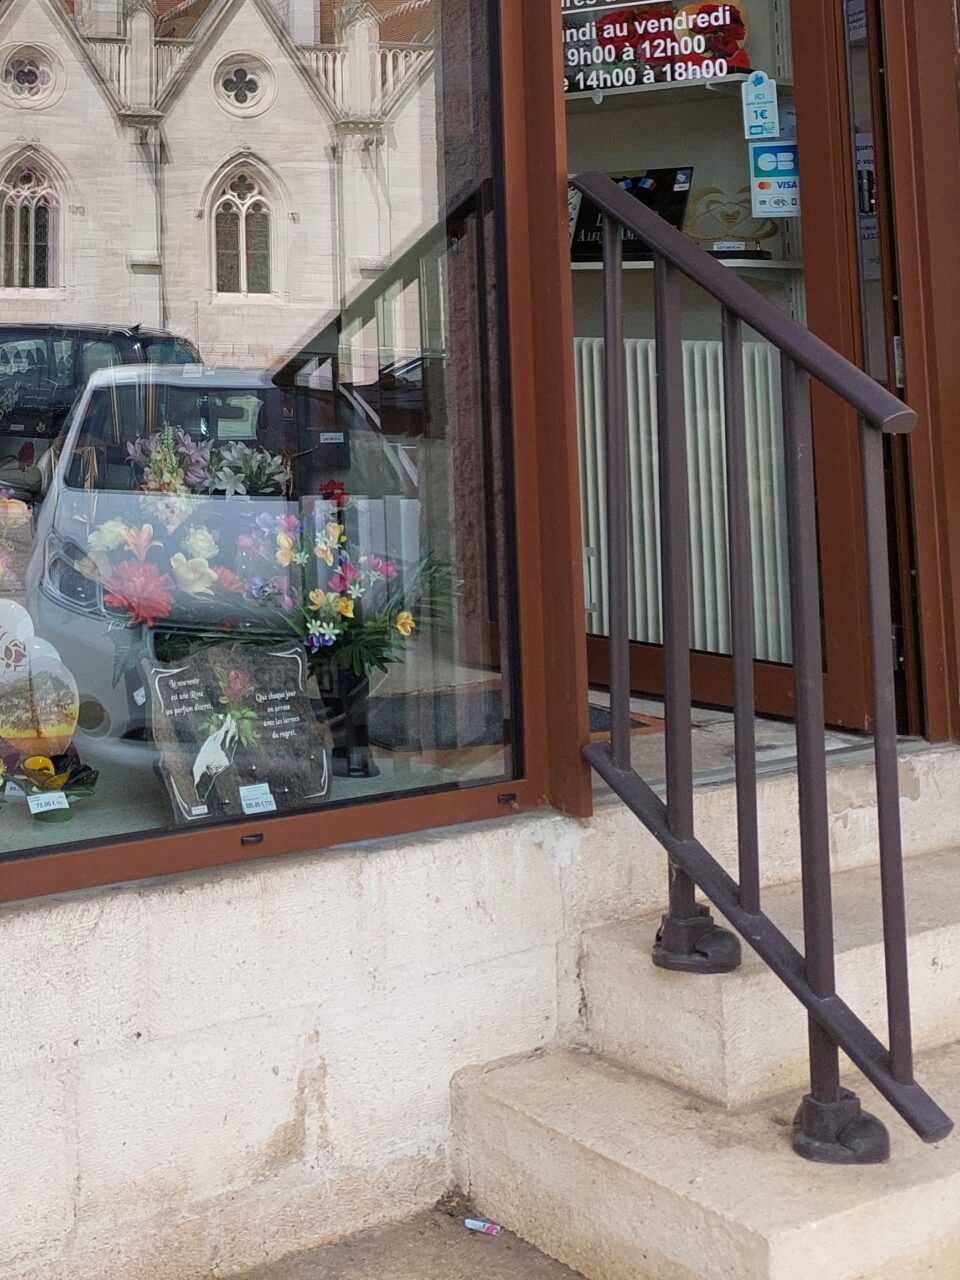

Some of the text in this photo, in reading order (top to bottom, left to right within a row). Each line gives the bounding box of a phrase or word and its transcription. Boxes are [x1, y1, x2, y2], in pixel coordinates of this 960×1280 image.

[602, 5, 732, 39] au vendredi
[566, 34, 706, 67] 9h00 à 12h00
[575, 57, 729, 91] 14h00 à 18h00
[776, 180, 798, 189] VISA
